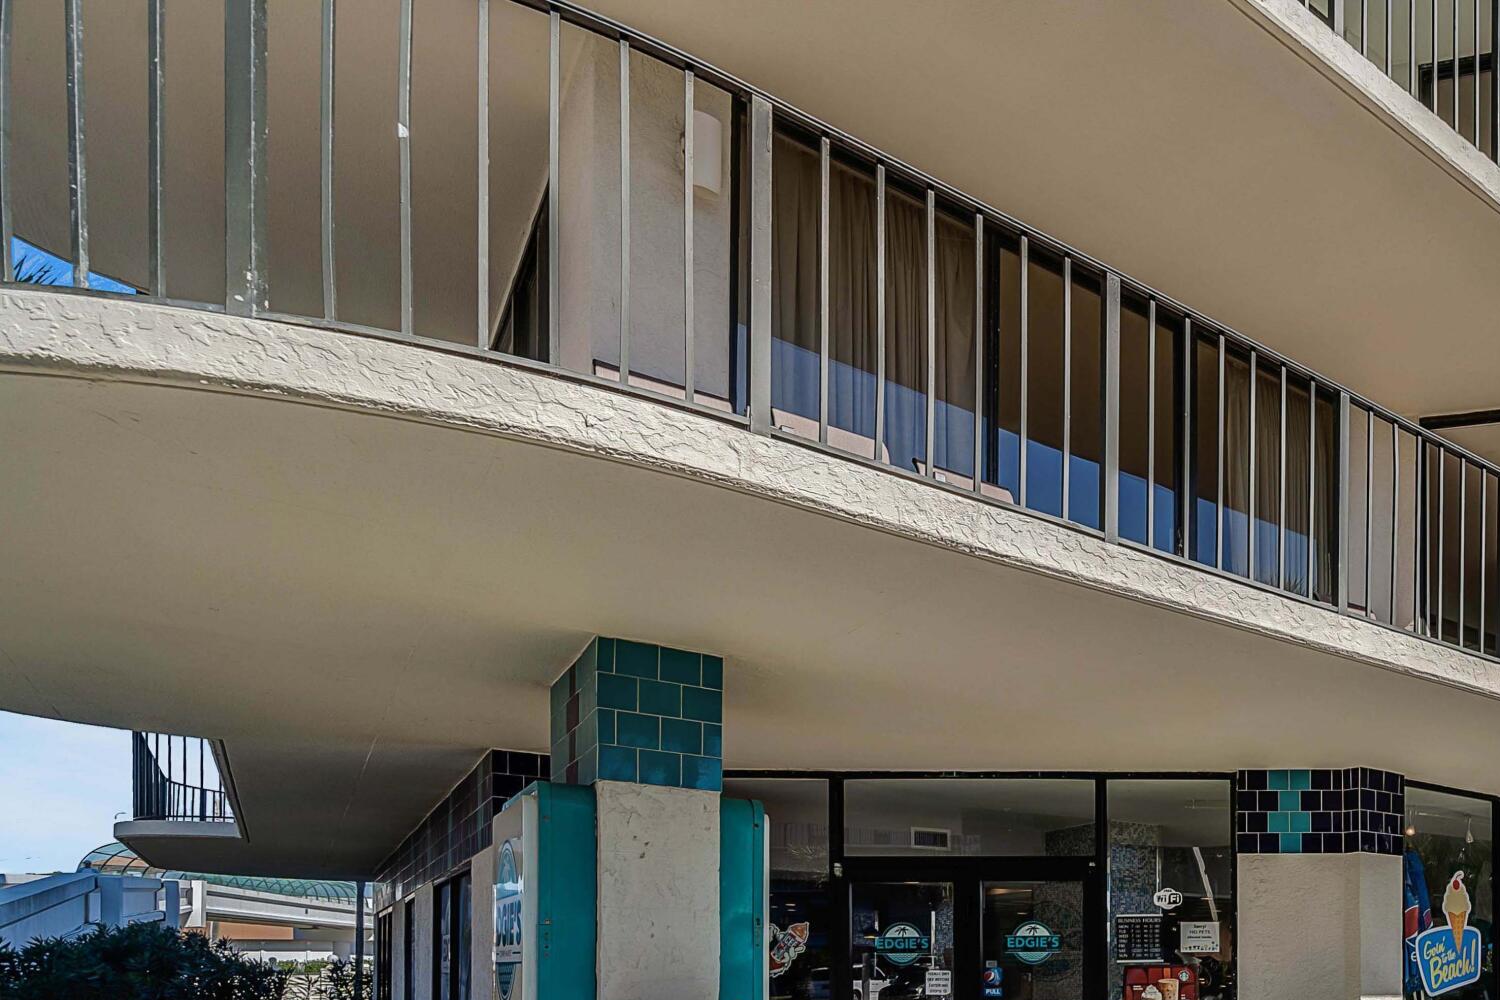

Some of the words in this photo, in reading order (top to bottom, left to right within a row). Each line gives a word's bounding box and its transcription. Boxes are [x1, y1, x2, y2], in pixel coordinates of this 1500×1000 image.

[875, 937, 930, 950] EDGIE'S
[1007, 935, 1060, 949] EDGIE'S
[1423, 936, 1446, 960] Goin'
[1429, 938, 1476, 990] Beach!
